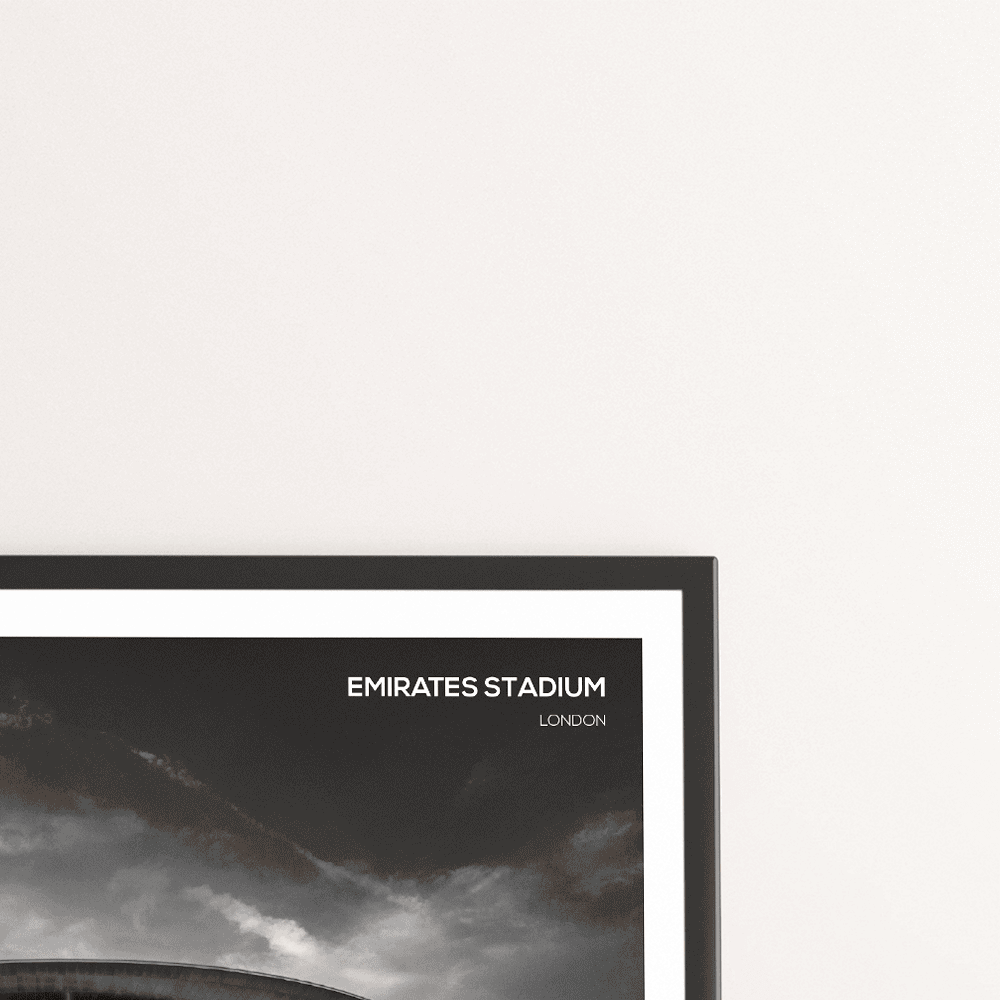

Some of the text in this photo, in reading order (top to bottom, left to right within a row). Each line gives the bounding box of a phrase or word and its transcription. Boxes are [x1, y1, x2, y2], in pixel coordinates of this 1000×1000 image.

[347, 676, 606, 698] EMIRATES STADIUM
[539, 714, 606, 727] LONDON
